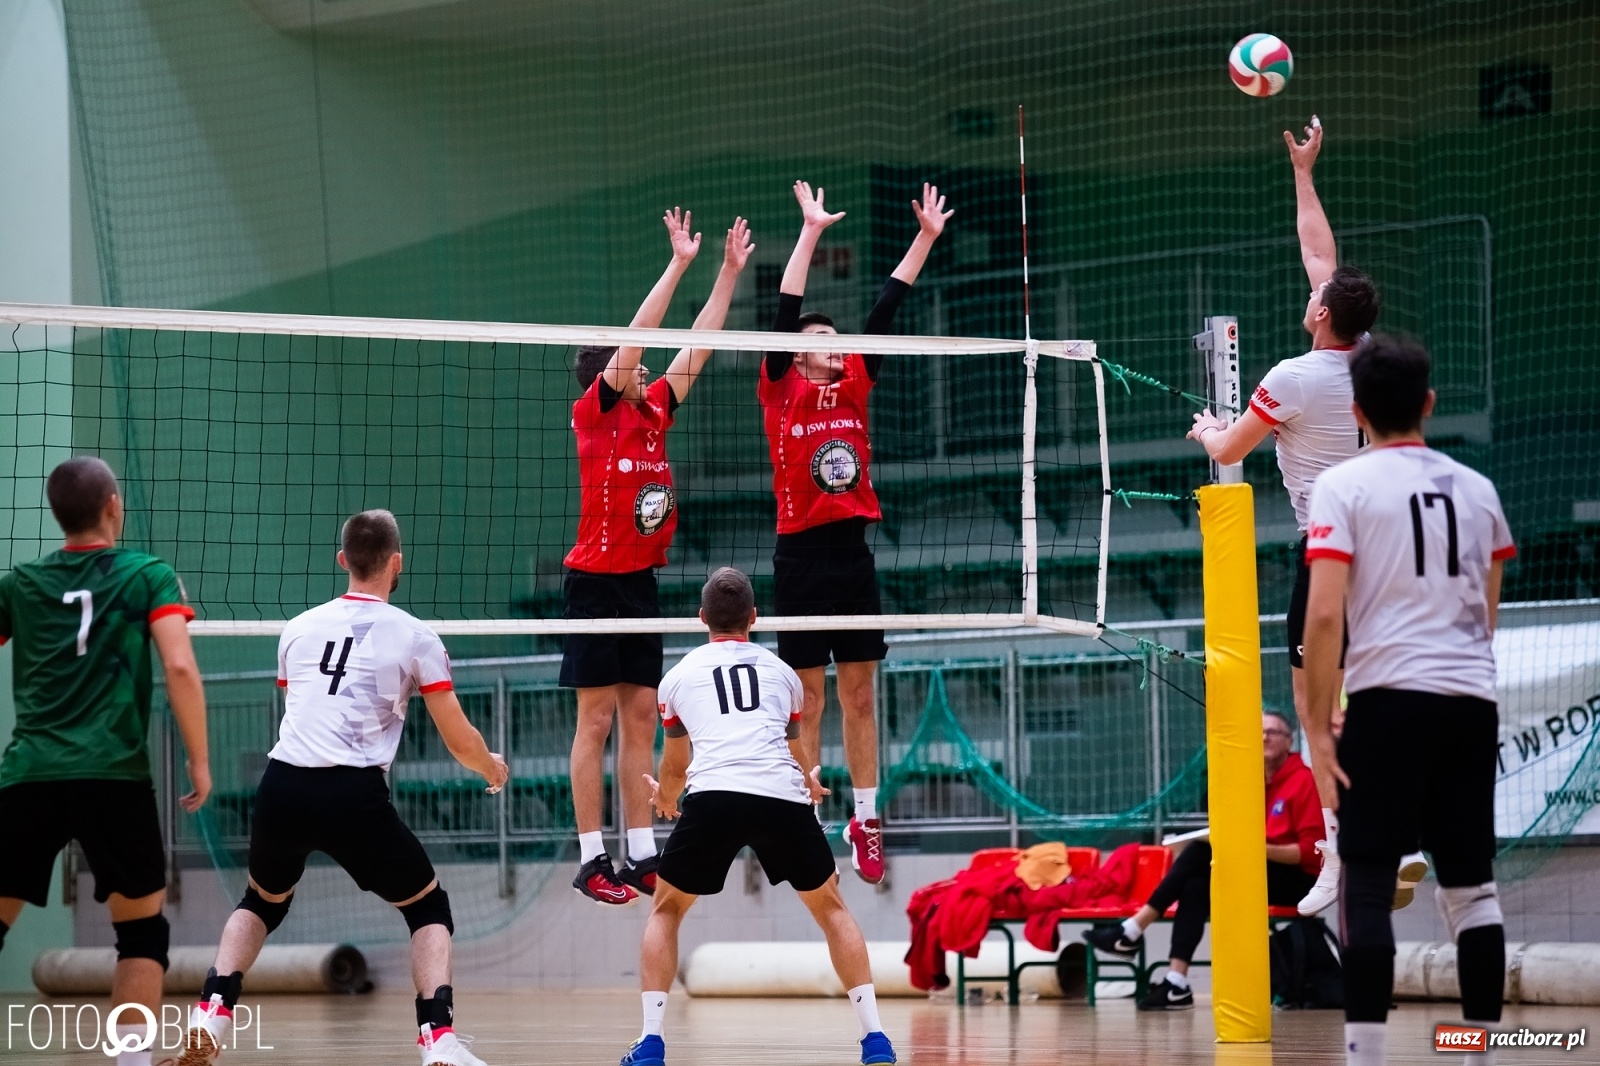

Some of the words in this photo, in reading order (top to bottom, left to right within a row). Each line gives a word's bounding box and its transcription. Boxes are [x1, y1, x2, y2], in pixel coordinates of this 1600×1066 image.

[817, 382, 840, 410] 15
[806, 421, 827, 436] JSW
[1410, 493, 1459, 577] 17
[62, 590, 93, 656] 7
[319, 637, 354, 696] 4
[712, 663, 761, 715] 10
[1512, 726, 1542, 763] W
